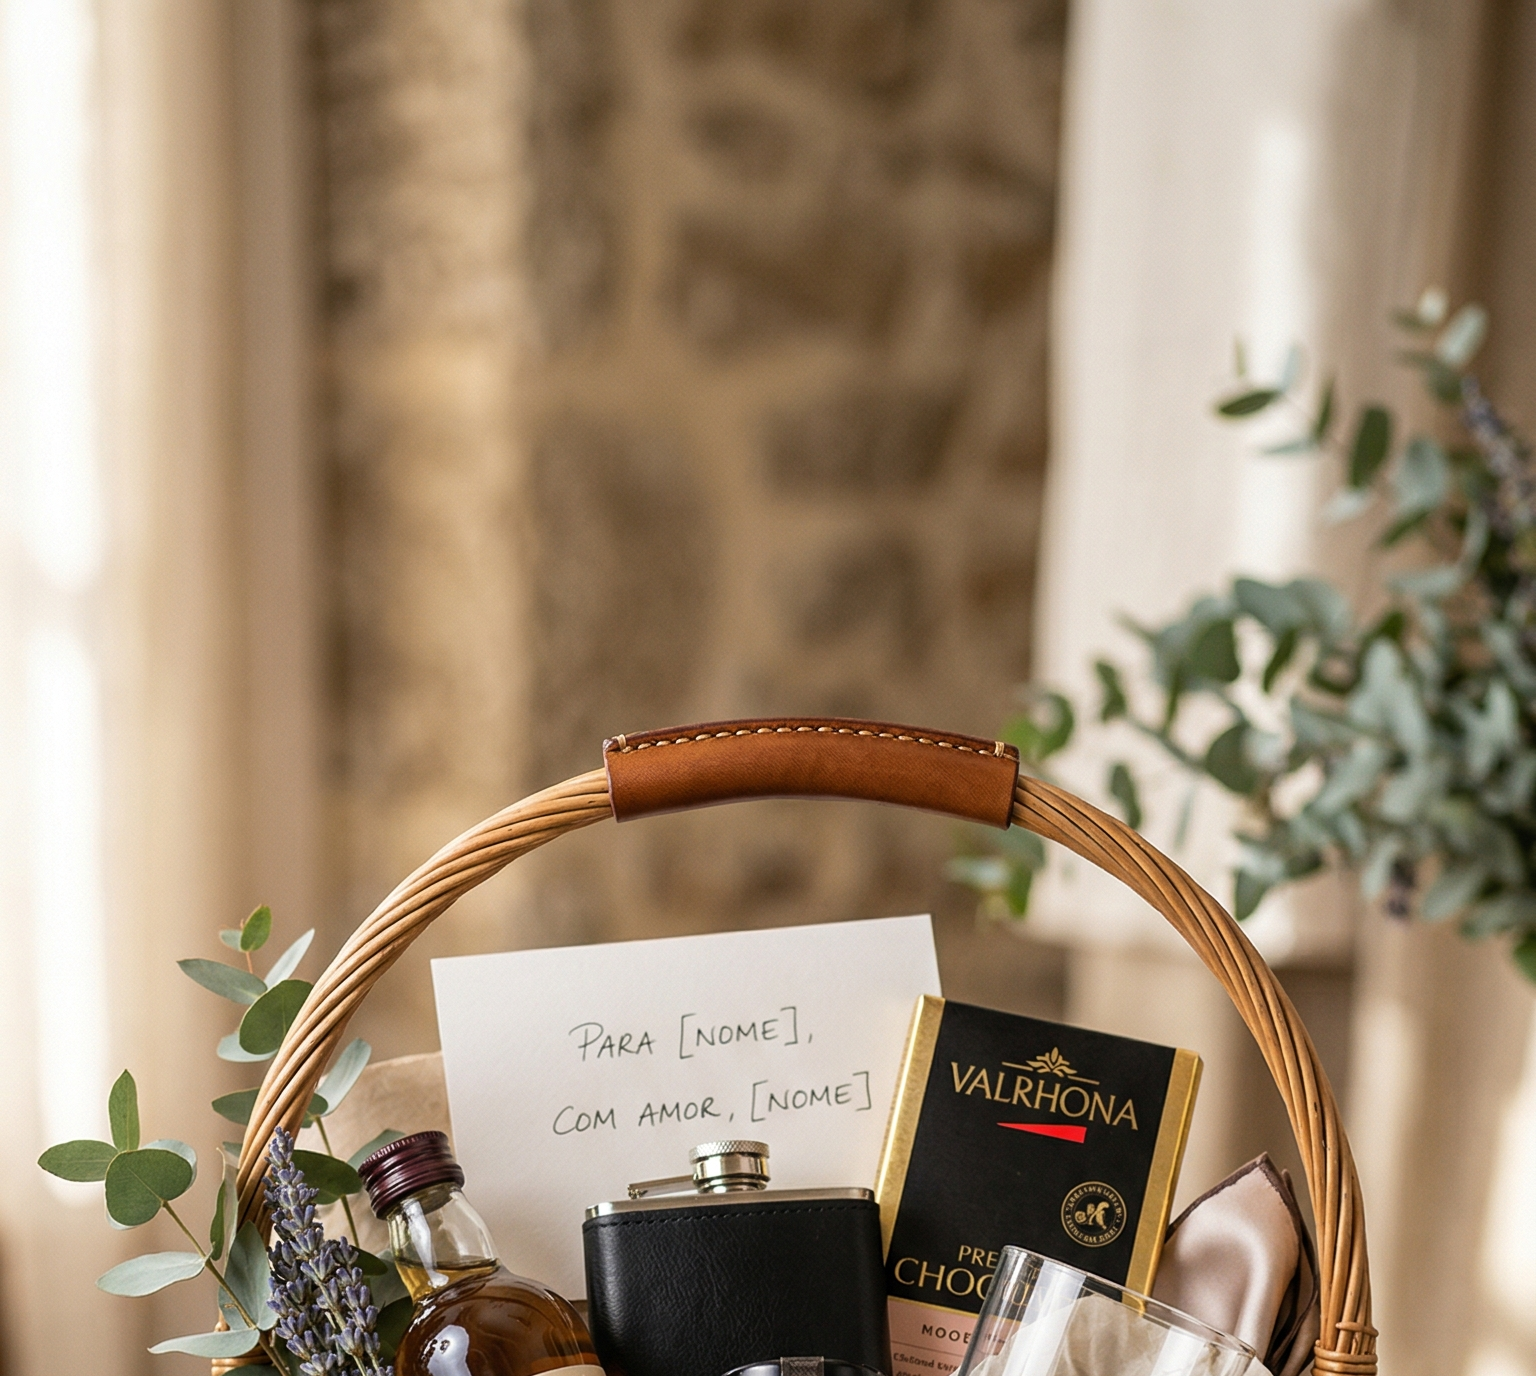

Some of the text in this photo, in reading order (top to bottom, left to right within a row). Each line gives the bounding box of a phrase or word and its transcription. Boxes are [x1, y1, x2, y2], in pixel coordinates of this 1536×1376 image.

[569, 1006, 813, 1061] PARA [NOME],
[552, 1071, 872, 1136] COM AMOR, [NOME]
[950, 1061, 1138, 1131] VALRHONA
[894, 1257, 992, 1301] CHOC
[958, 1245, 999, 1269] PRE
[922, 1324, 972, 1344] MOOE
